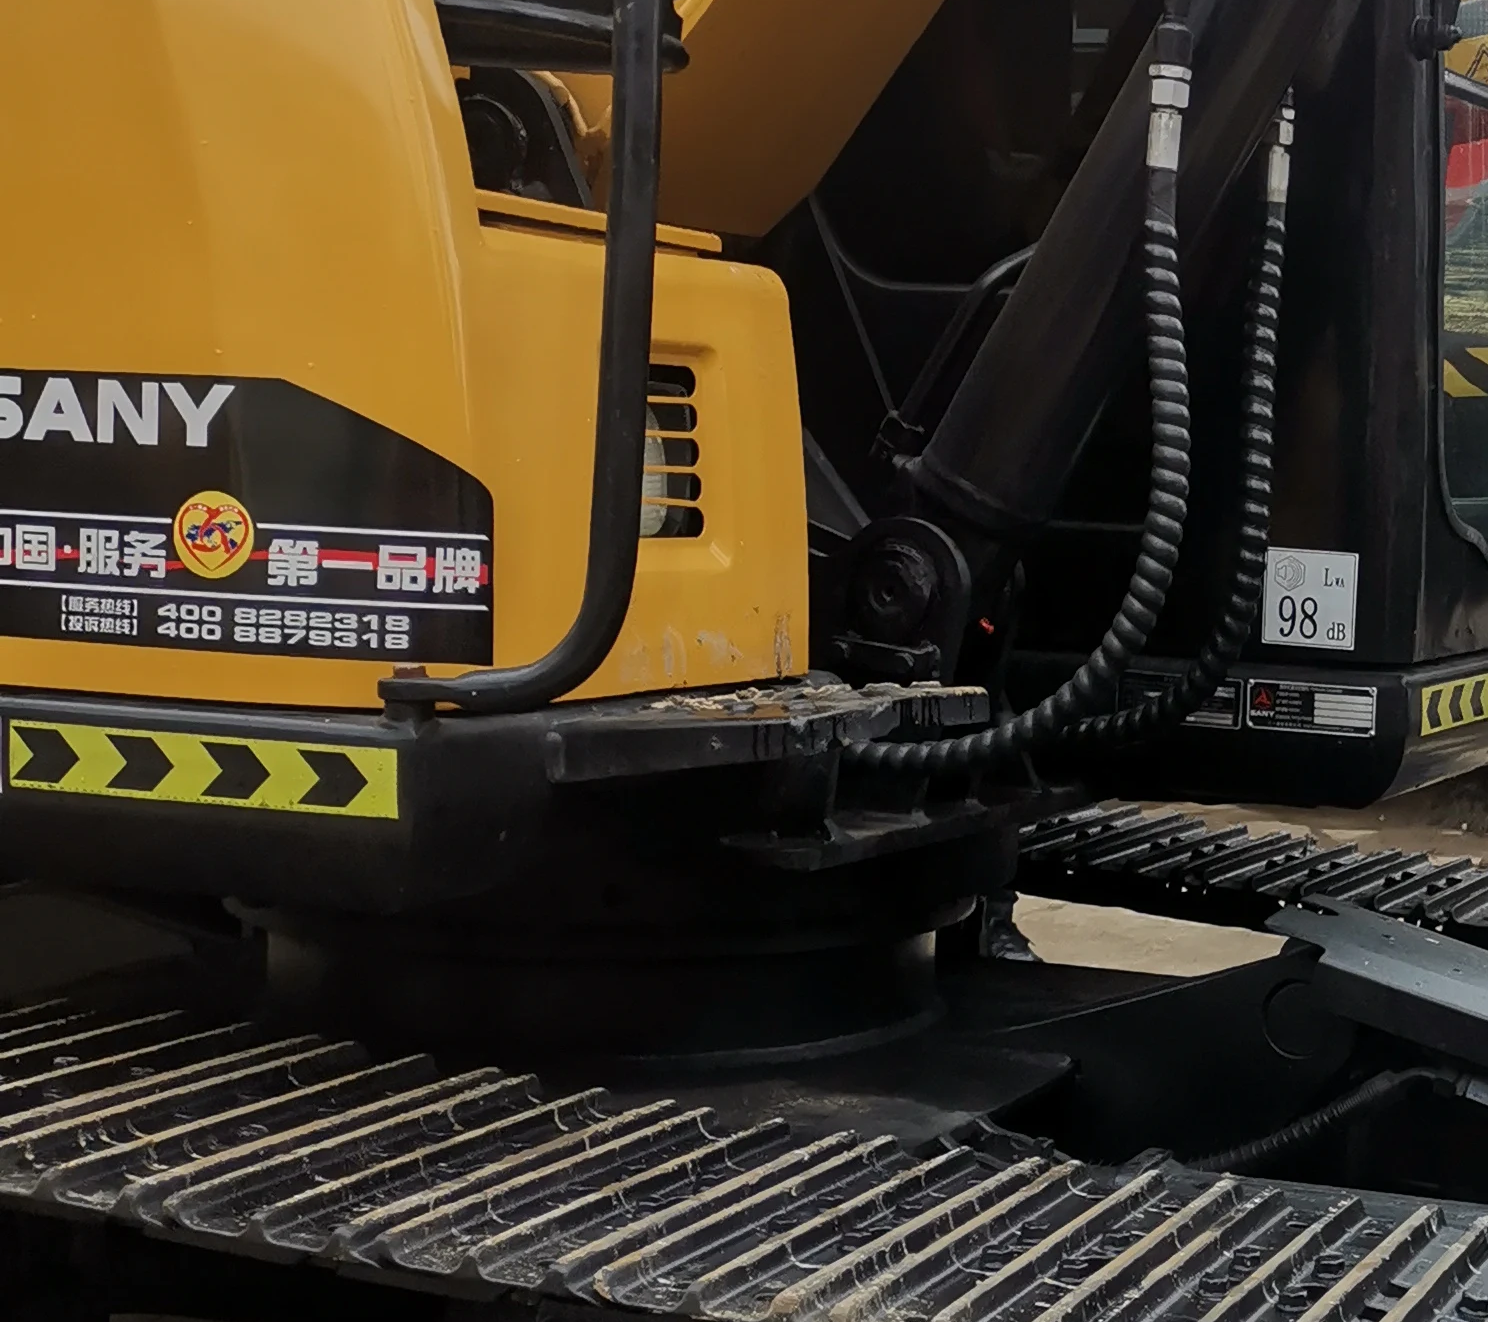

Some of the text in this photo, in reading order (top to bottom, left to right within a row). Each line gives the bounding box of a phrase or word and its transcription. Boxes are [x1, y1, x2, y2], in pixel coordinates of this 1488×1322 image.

[267, 538, 481, 594] 第一品牌
[157, 603, 222, 623] 400
[234, 607, 410, 632] 8282318
[157, 621, 222, 641] 400
[233, 626, 410, 650] 8879318
[1278, 595, 1346, 641] 98 dB
